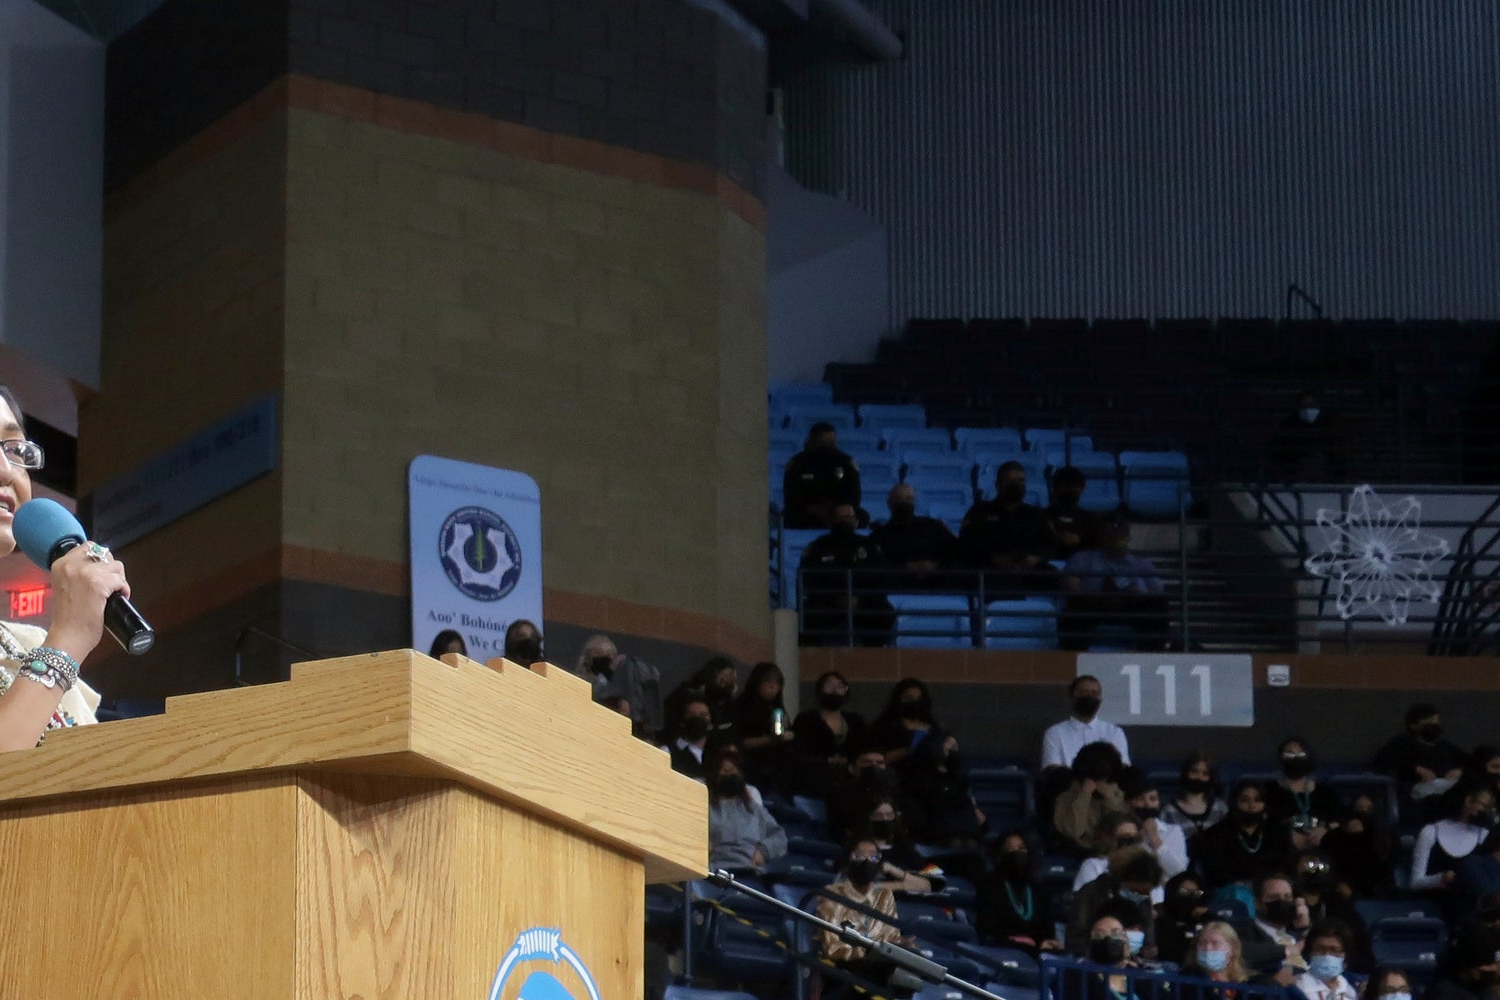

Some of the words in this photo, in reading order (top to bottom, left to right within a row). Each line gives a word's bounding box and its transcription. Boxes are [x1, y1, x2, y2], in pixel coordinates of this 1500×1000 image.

[18, 589, 45, 617] EXIT
[469, 634, 489, 650] We
[1120, 664, 1212, 716] 111
